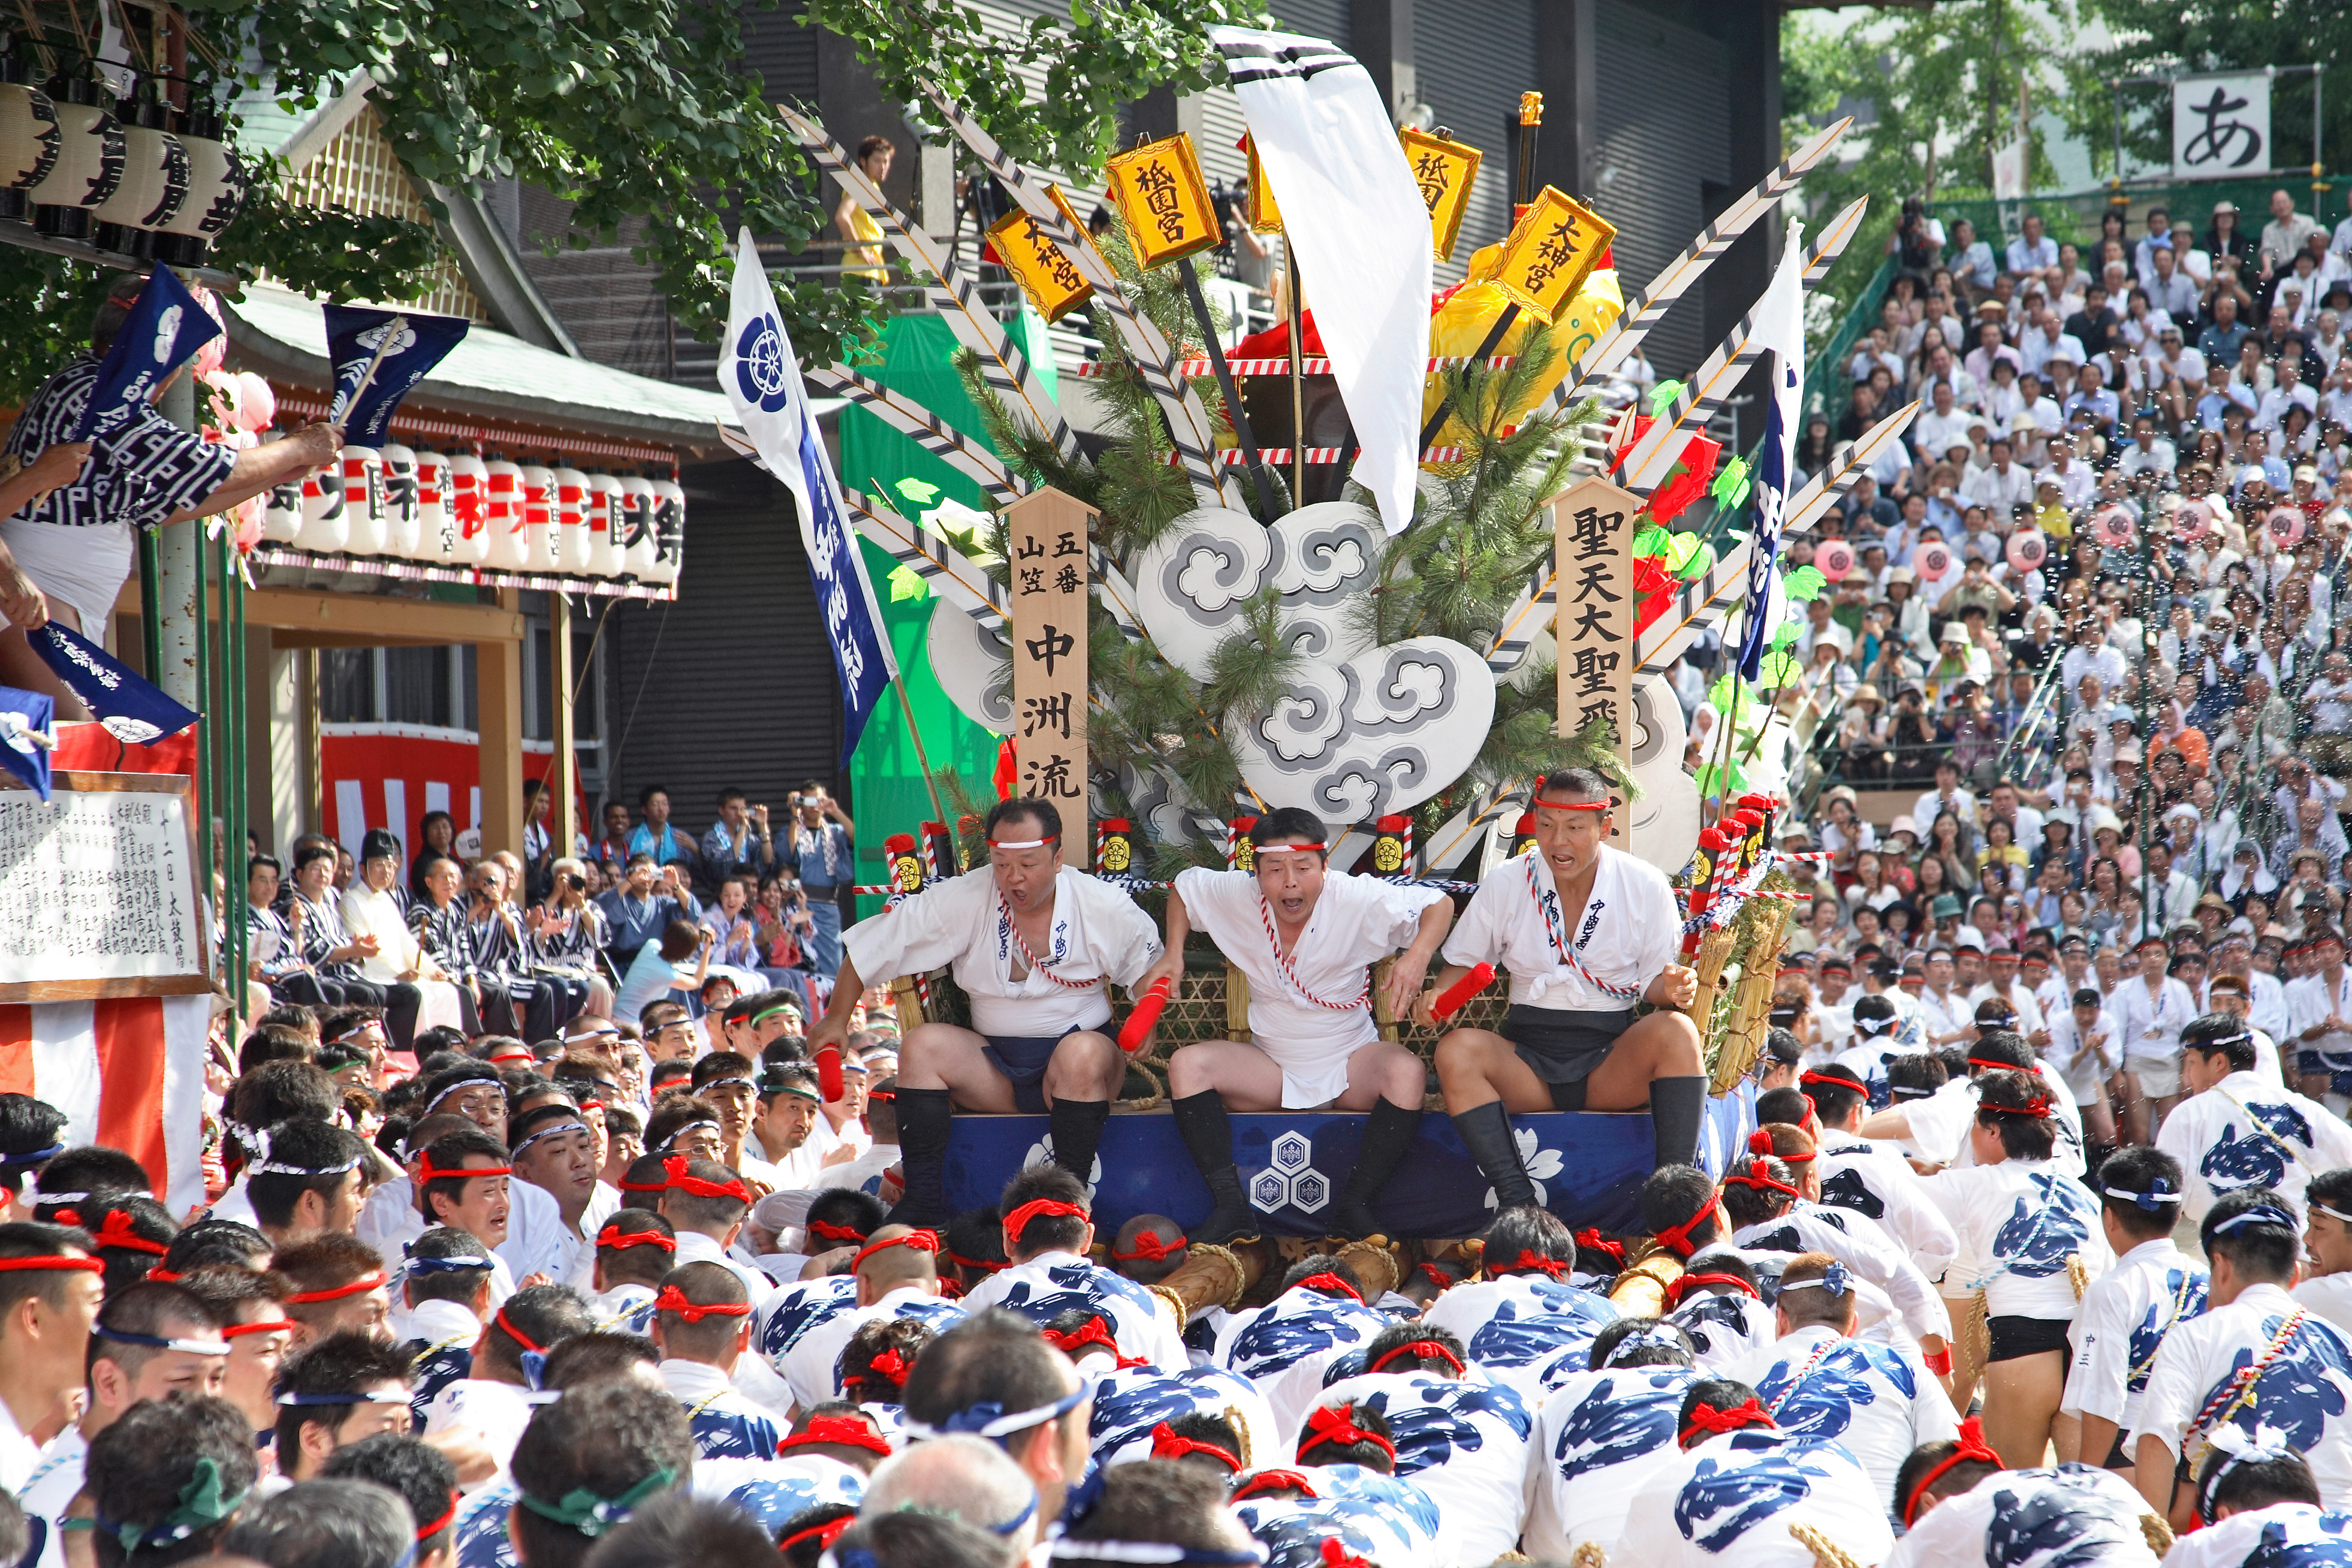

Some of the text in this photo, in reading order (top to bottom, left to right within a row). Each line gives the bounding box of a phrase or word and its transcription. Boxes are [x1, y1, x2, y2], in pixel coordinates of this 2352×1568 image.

[2184, 86, 2261, 168] あ
[1023, 215, 1082, 293] 大神宮
[1524, 214, 1581, 295] 大神宮
[1017, 535, 1047, 596] 山笠
[1051, 531, 1084, 593] 五番
[1023, 623, 1081, 798] 中洲流
[2079, 1334, 2095, 1366] 中三
